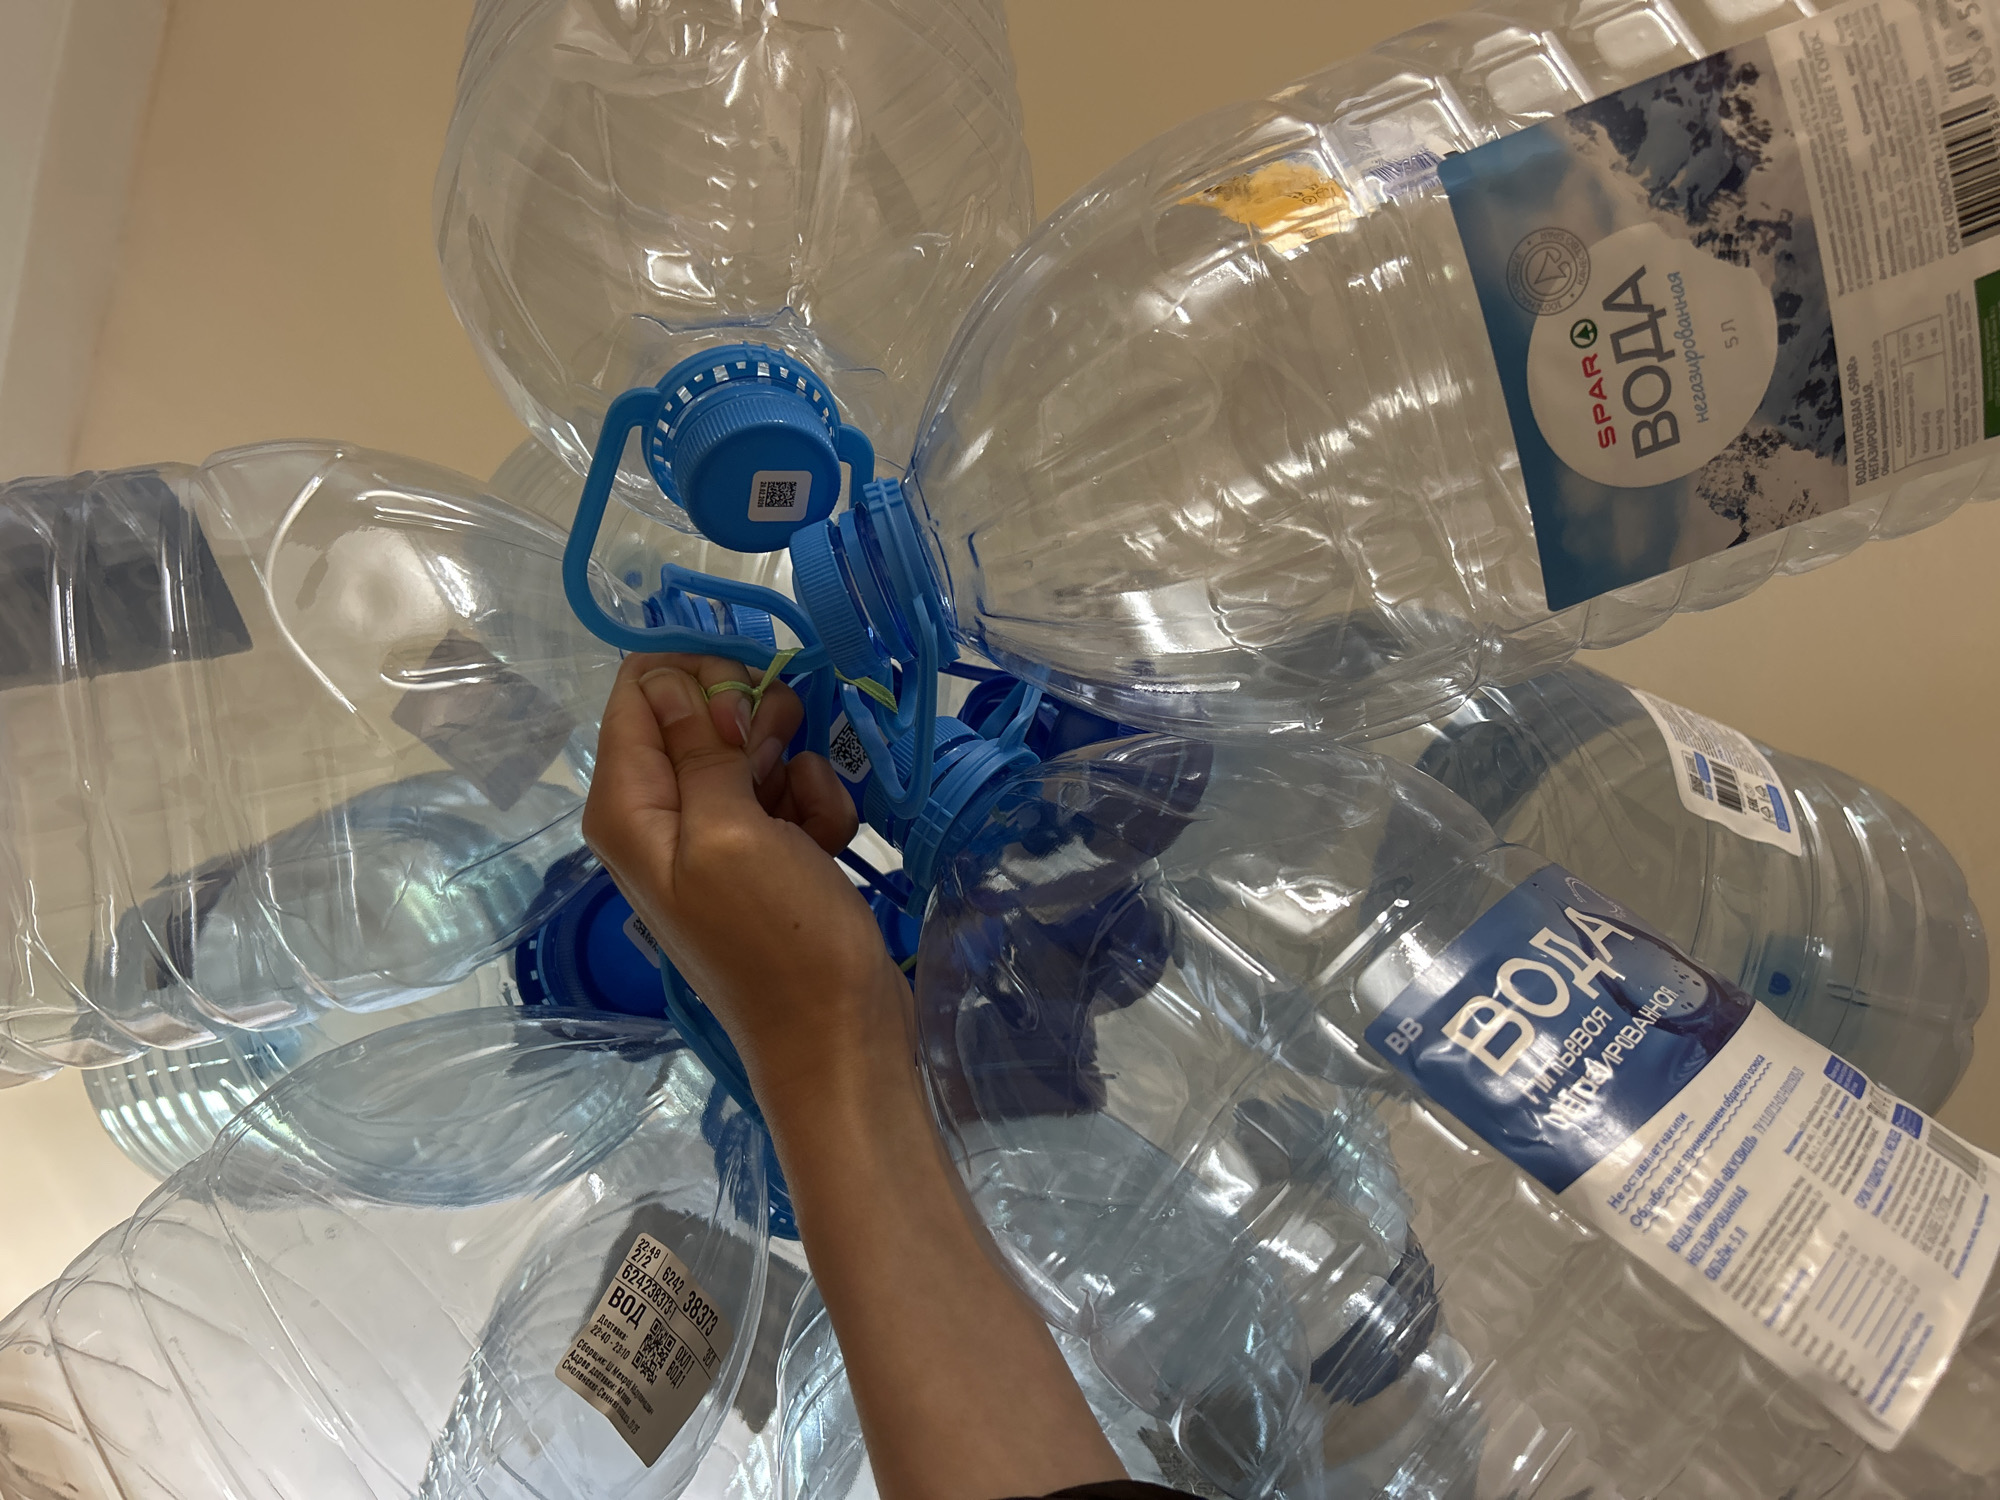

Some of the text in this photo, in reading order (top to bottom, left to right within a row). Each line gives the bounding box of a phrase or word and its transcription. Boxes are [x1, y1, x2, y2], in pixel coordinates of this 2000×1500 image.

[1945, 222, 1960, 256] СРОК
[1602, 264, 1680, 459] ВОДА
[1667, 271, 1709, 424] негазированная
[1724, 336, 1739, 349] 5
[1582, 353, 1616, 449] SPAR
[1850, 397, 1865, 456] ПИТЬЕВАЯ
[1855, 457, 1867, 486] ВОДА
[1441, 906, 1635, 1077] ВОДА
[1384, 1017, 1424, 1056] ВВ
[1606, 1112, 1689, 1209] Не оставляет накипи
[1629, 1165, 1682, 1227] Обработана
[1681, 1107, 1725, 1164] применением
[1723, 1072, 1751, 1111] обратного
[1667, 1229, 1694, 1253] ВОДА
[1686, 1178, 1726, 1227] ПИТЬЕВАЯ
[1685, 1185, 1750, 1267] НЕГАЗИРОВАННАЯ
[631, 1248, 652, 1269] 2/2
[637, 1237, 662, 1259] 22:48
[607, 1285, 647, 1331] ВОД
[621, 1264, 677, 1321] 624238373-1
[662, 1266, 719, 1337] 6242 38373
[576, 1338, 608, 1366] Сборщик:
[590, 1324, 612, 1344] 22:40
[612, 1341, 631, 1360] 23:10
[597, 1314, 628, 1341] Доставка:
[568, 1349, 591, 1370] Адрес
[588, 1366, 618, 1391] доставки:
